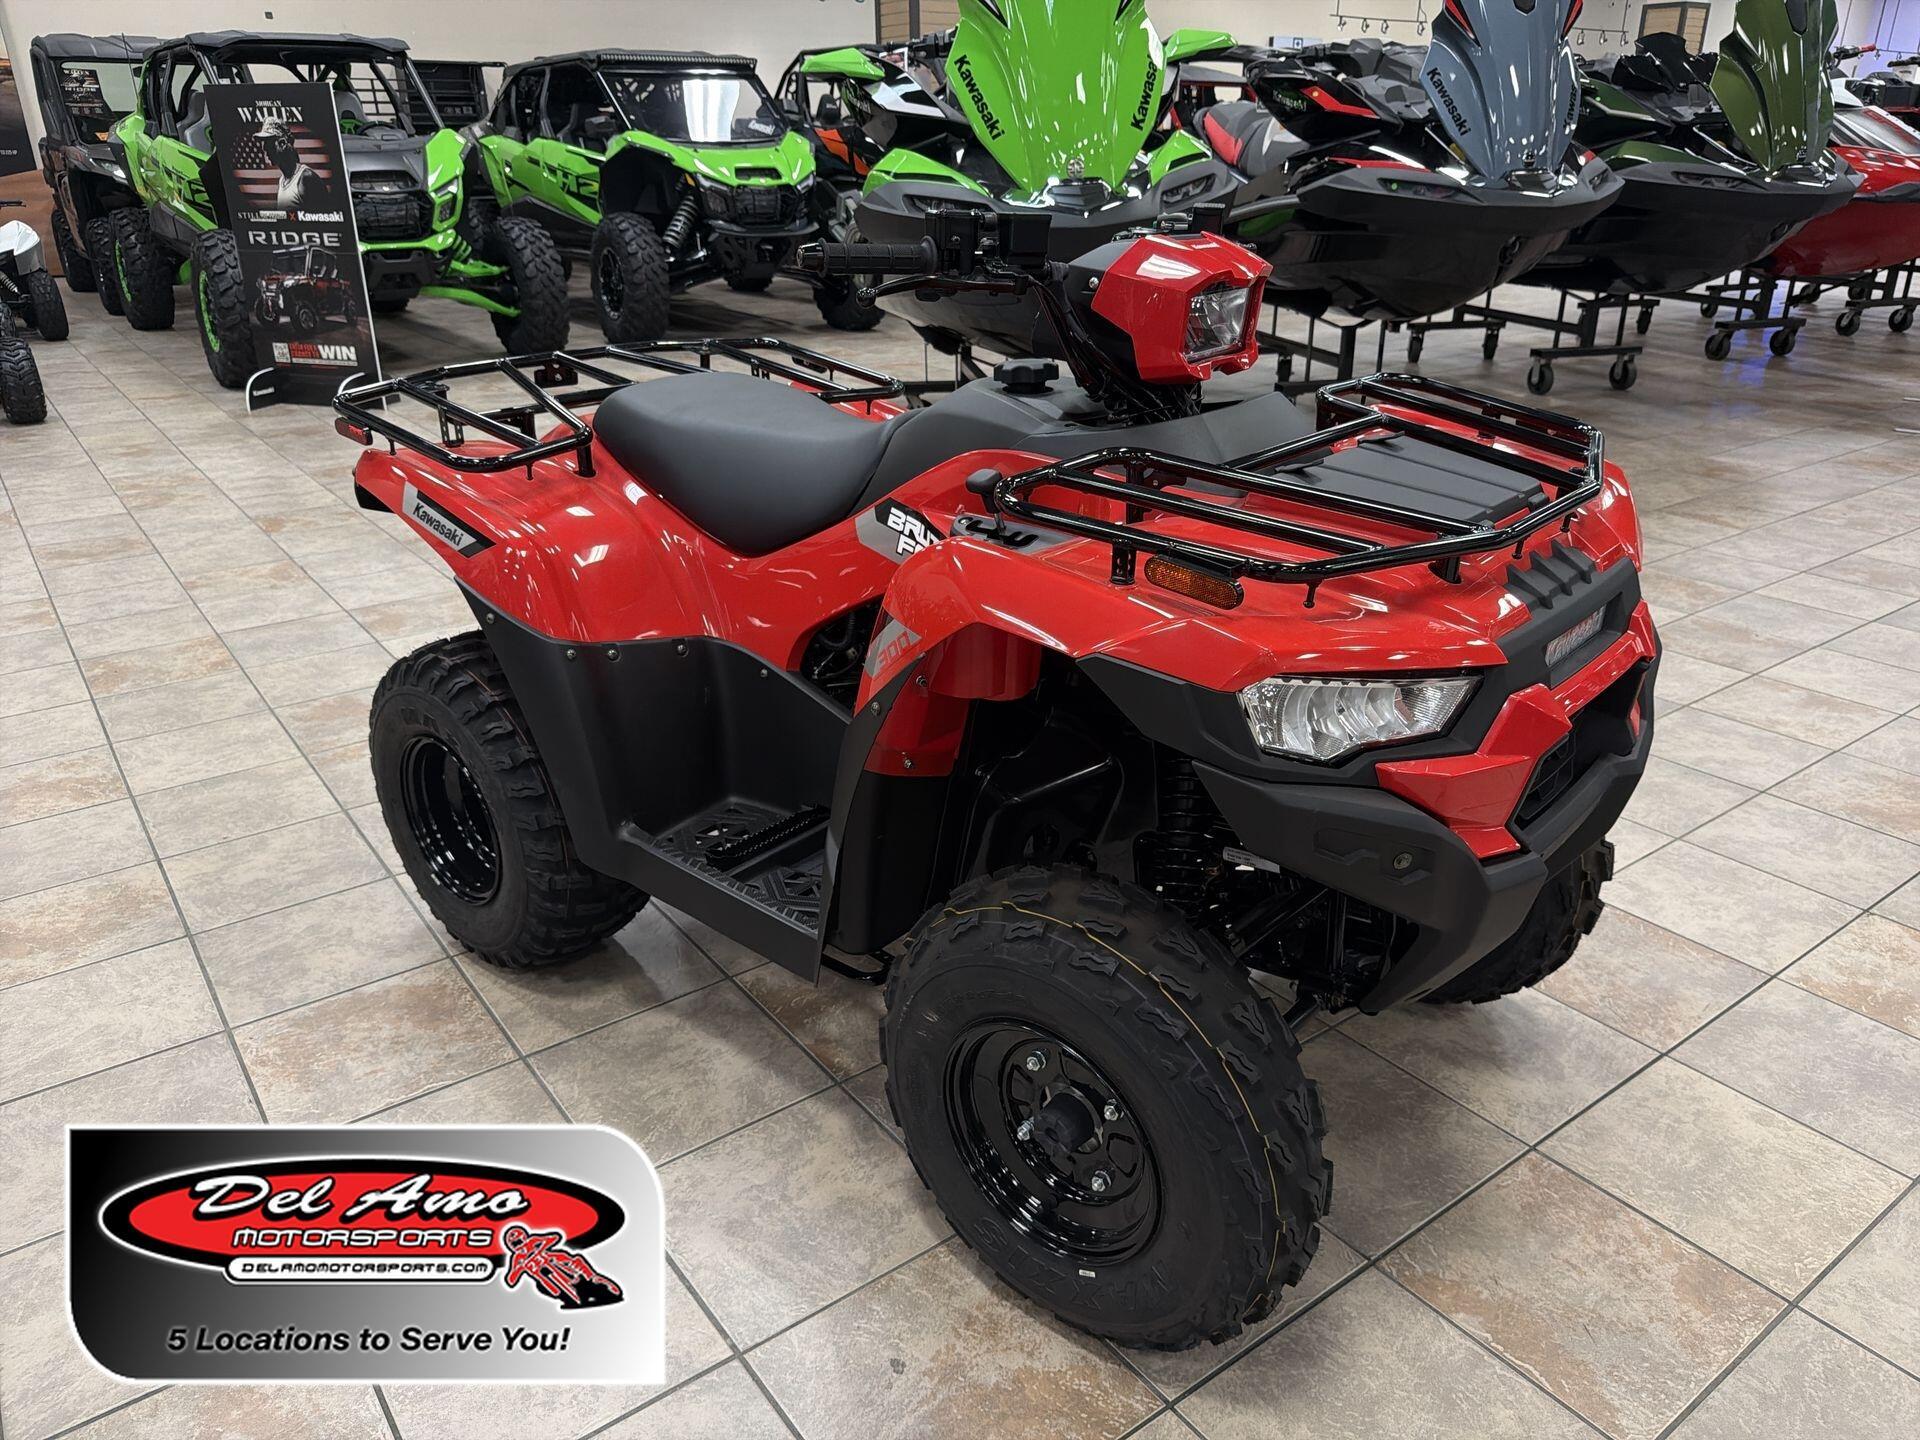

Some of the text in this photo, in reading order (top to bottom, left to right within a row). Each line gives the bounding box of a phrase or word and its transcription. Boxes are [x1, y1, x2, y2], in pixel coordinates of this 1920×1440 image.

[954, 54, 1006, 141] Kawasaki
[1131, 54, 1158, 132] Kawasa
[1427, 67, 1472, 137] Kawasaki
[297, 210, 344, 223] Kawasaki
[248, 231, 341, 247] RIDGE
[317, 344, 358, 361] WIN
[413, 502, 464, 547] Kawasaki
[887, 506, 940, 548] BRU
[896, 533, 925, 555] F
